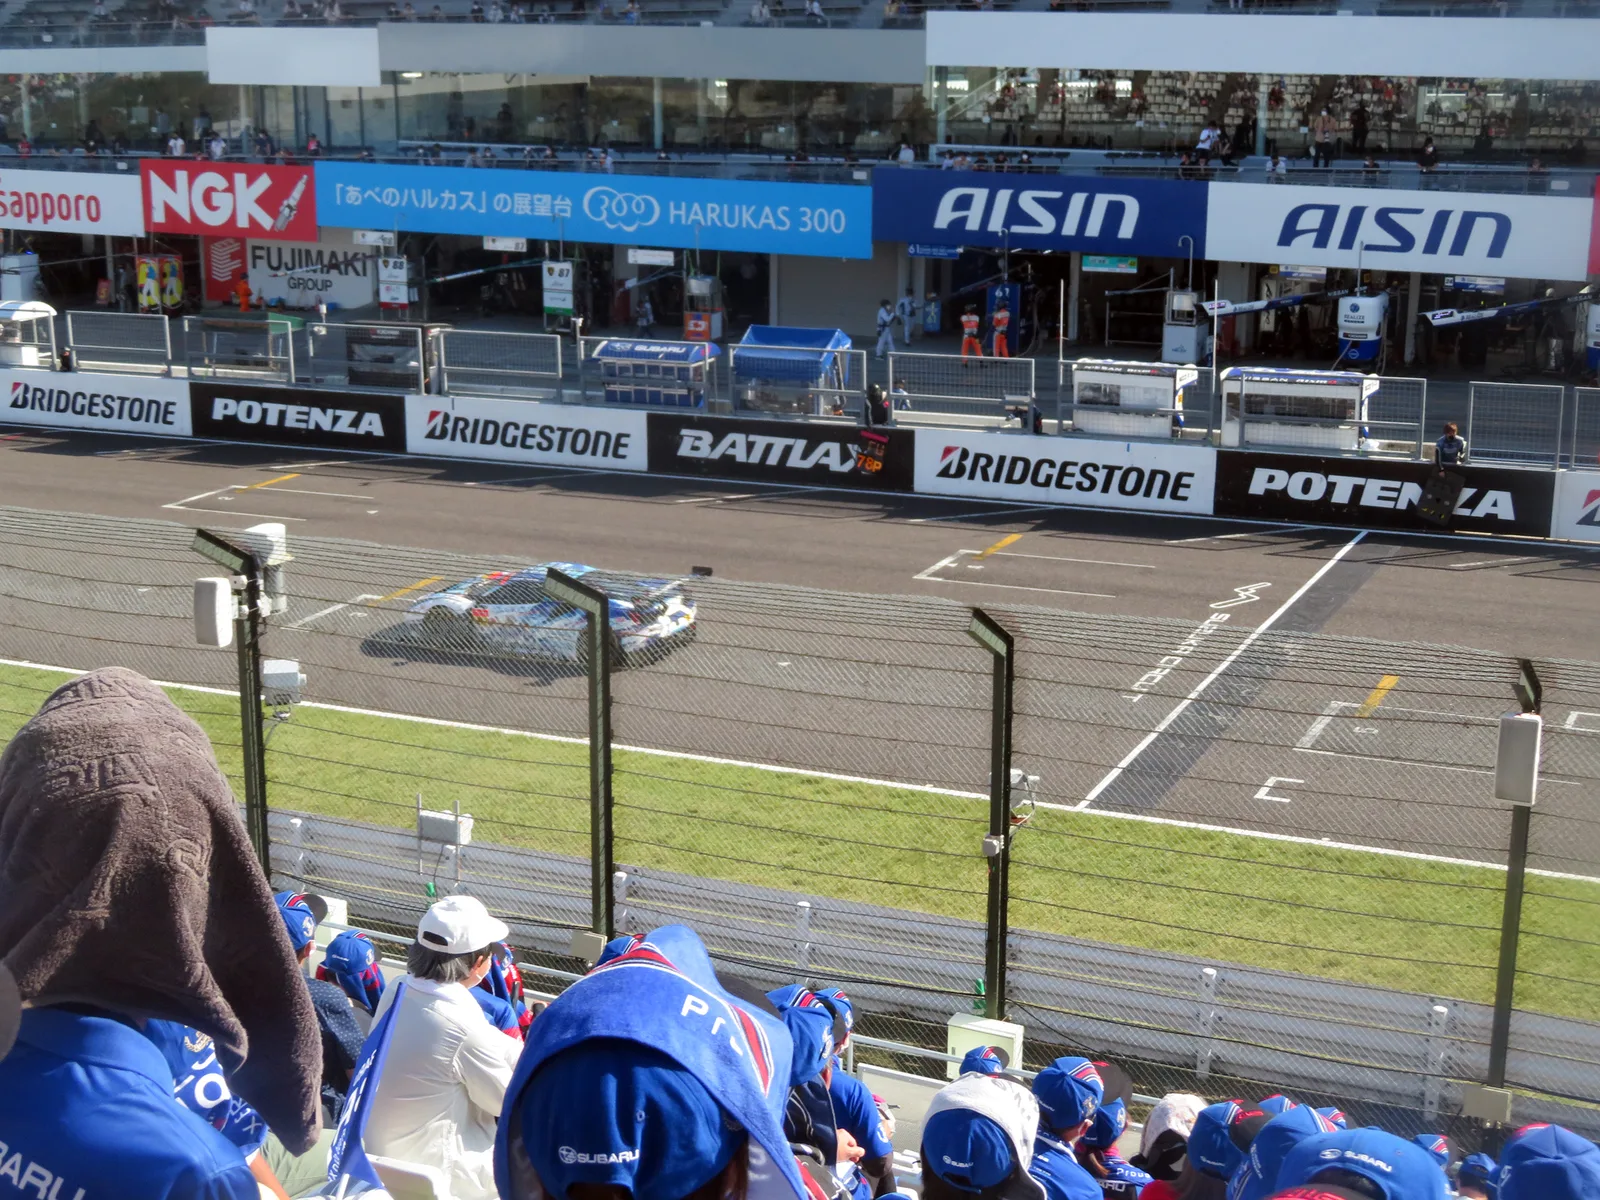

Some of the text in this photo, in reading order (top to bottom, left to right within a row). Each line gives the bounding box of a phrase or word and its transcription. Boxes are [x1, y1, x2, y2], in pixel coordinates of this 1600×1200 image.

[149, 169, 274, 232] NGK
[335, 183, 573, 218] 「あべのハルカス」の展望台
[669, 201, 847, 234] HARUKAS 300
[933, 187, 1140, 239] AISIN
[1277, 203, 1512, 259] AISIN
[251, 245, 368, 277] FUJIMAKI
[287, 277, 333, 292] GROUP
[634, 345, 687, 353] SUBARU
[10, 381, 178, 426] BRIDGESTONE
[211, 397, 385, 437] POTENZA
[424, 410, 632, 460] BRIDGESTONE
[857, 454, 883, 472] 78P
[936, 445, 1195, 502] BRIDGESTONE
[577, 1149, 640, 1164] SUBARU
[1344, 1150, 1393, 1172] SUBARU
